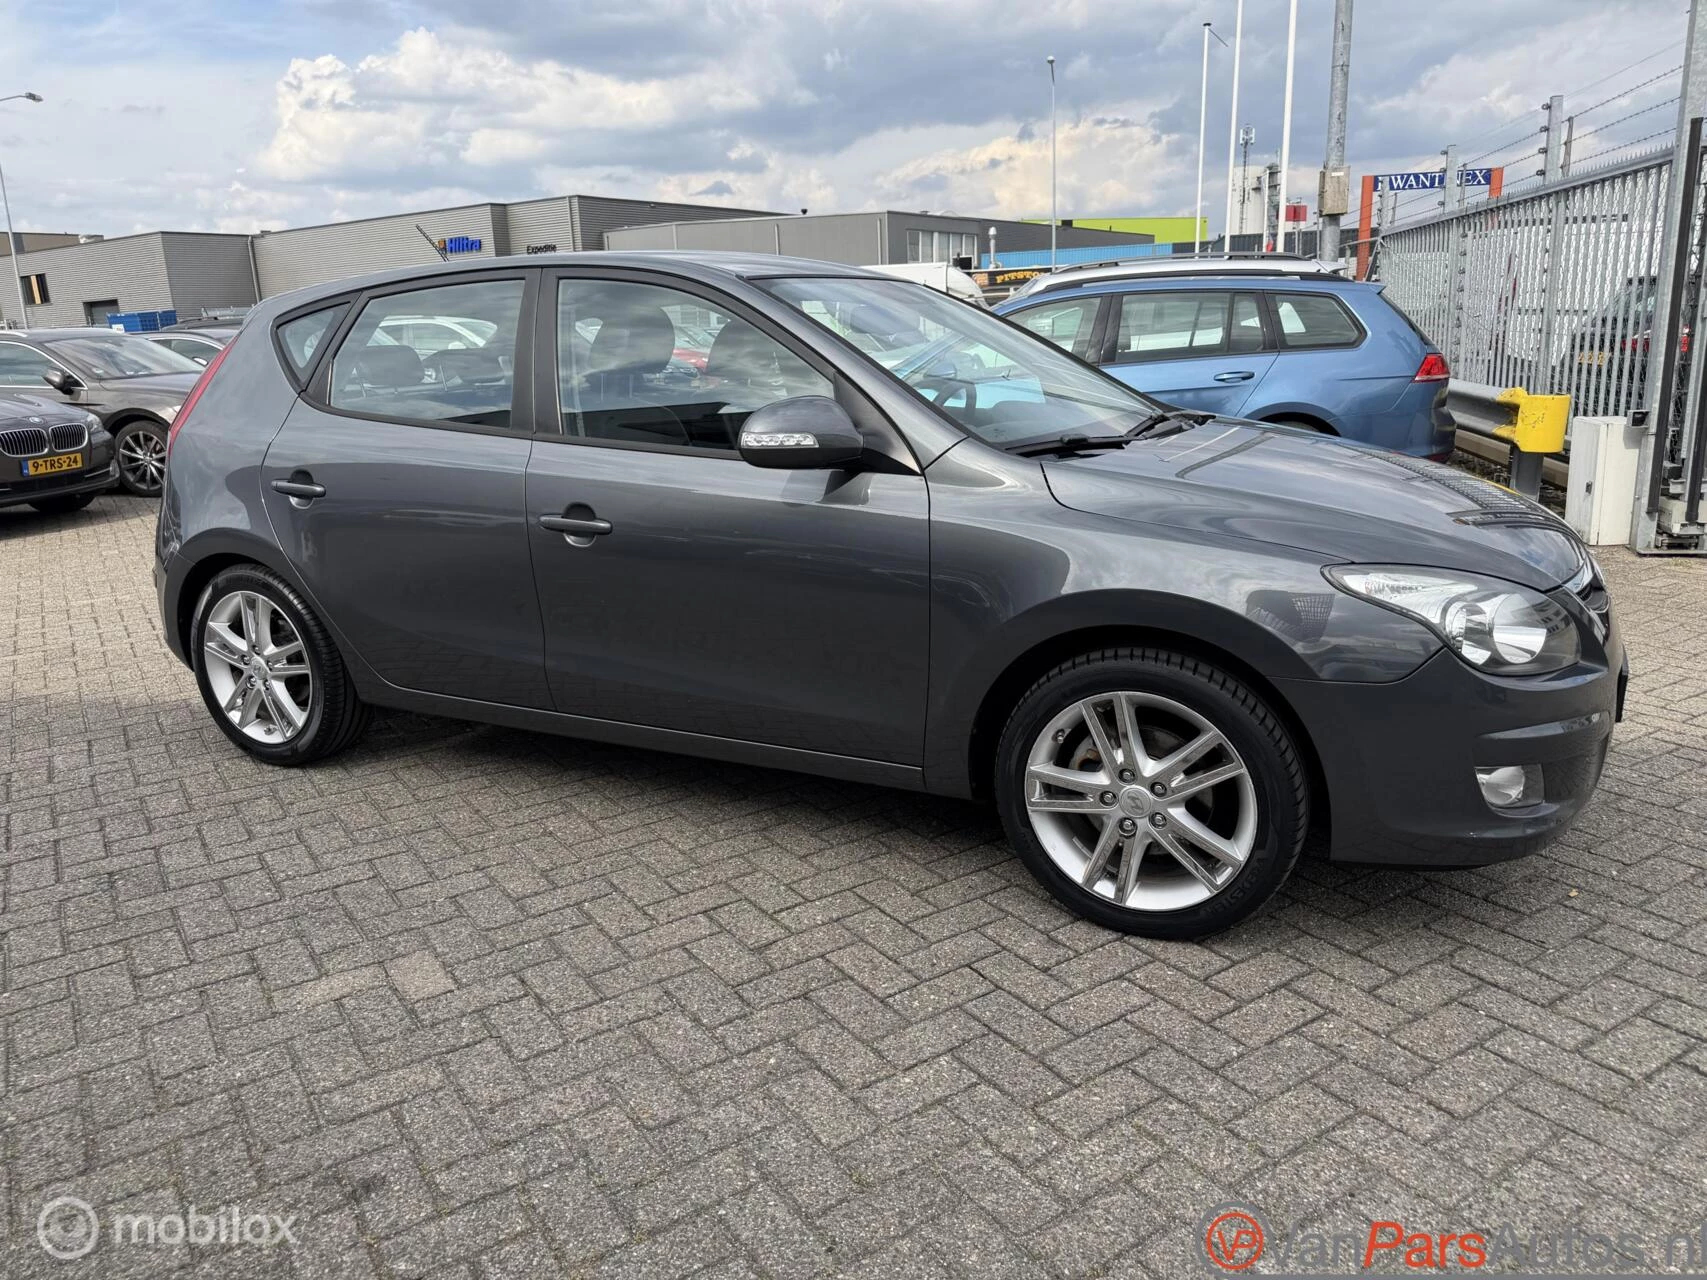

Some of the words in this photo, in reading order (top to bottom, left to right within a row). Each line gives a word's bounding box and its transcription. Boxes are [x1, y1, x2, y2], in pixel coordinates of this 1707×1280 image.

[448, 236, 481, 253] Hiltra
[996, 271, 1043, 283] PITSTO
[32, 455, 78, 472] 9-TRS-24
